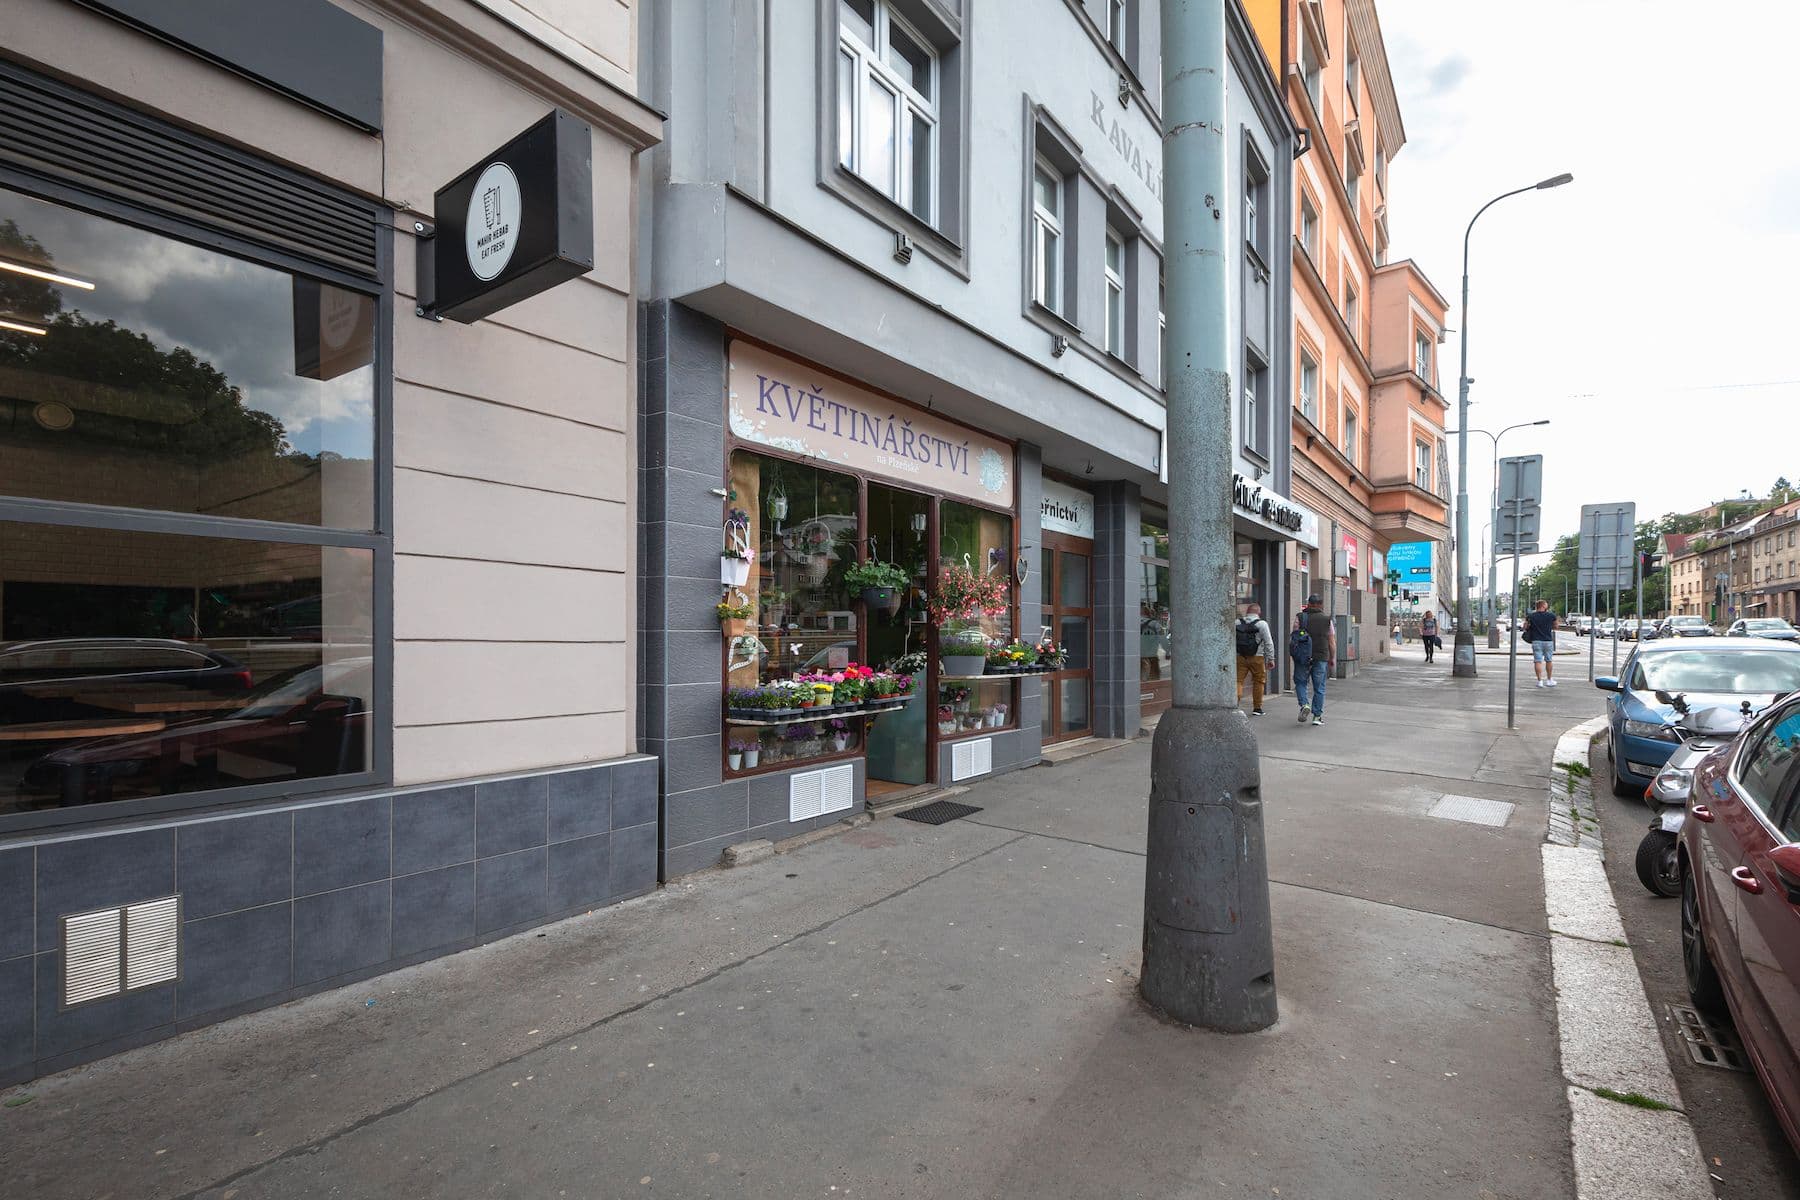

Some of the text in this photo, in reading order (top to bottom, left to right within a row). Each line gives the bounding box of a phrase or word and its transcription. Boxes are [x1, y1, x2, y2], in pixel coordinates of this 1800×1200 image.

[477, 233, 492, 249] MAHIR
[481, 240, 506, 260] EAT FRESH
[756, 374, 970, 476] KVĚTINÁŘSTVÍ
